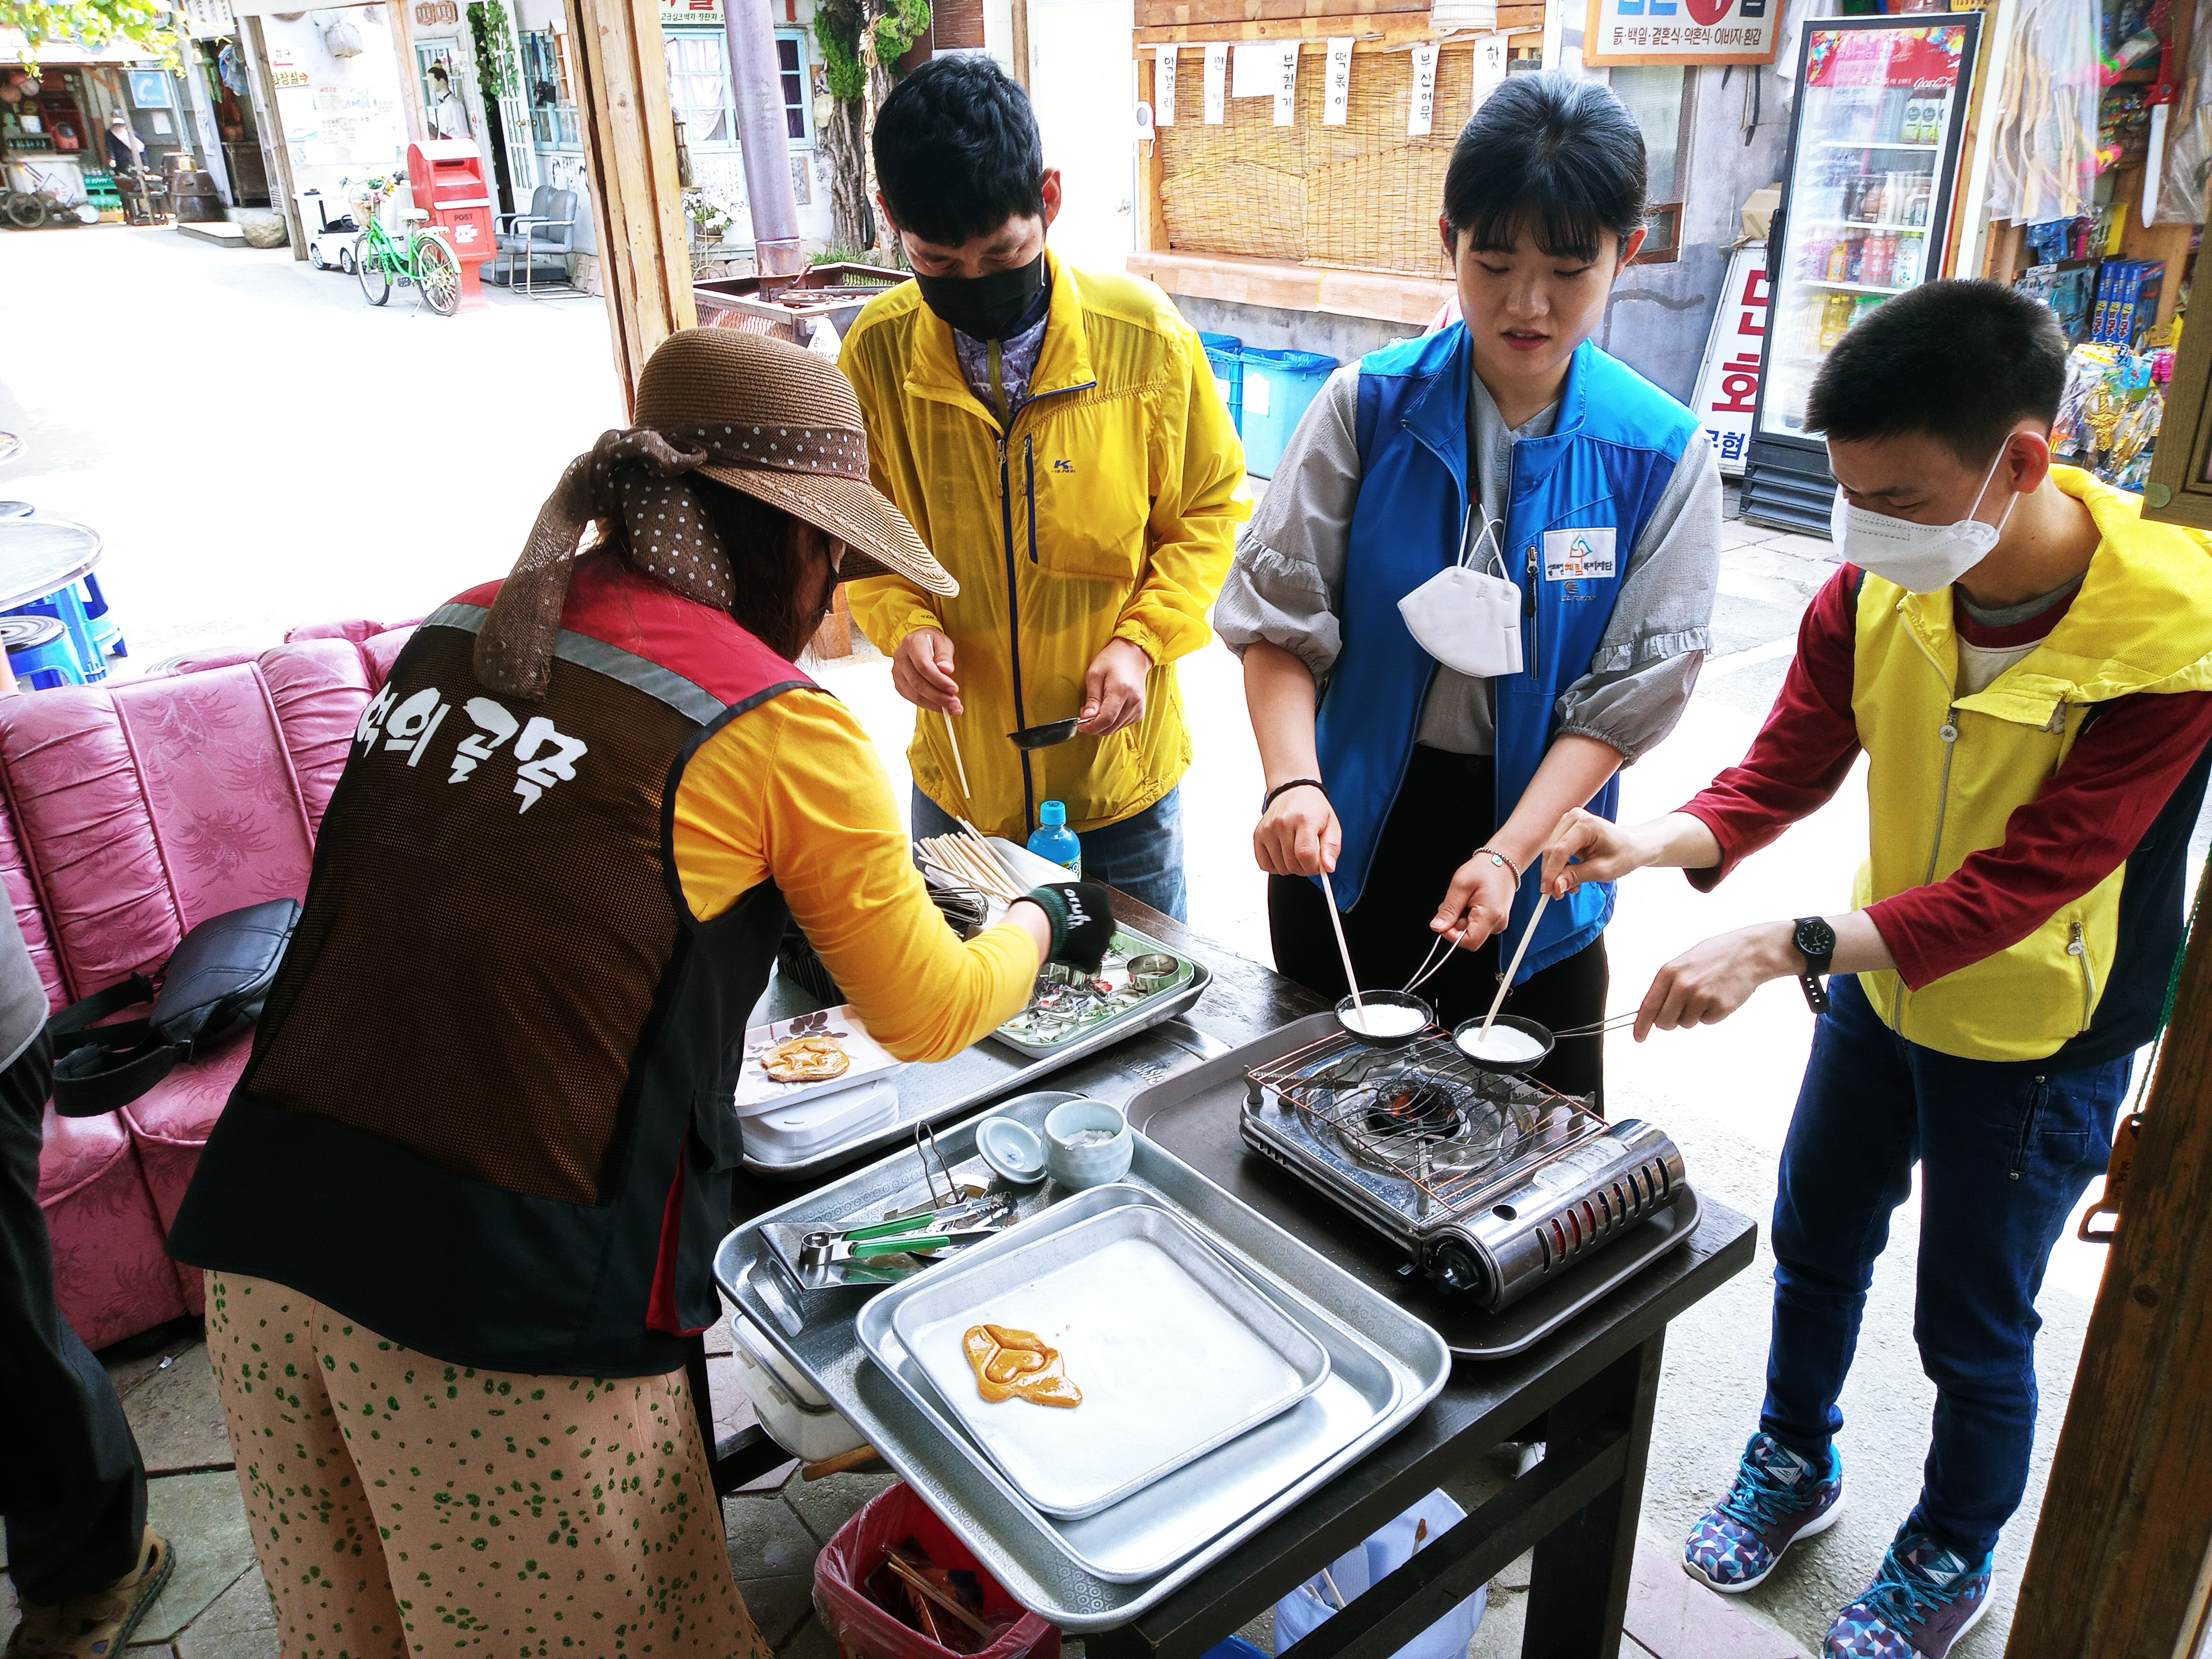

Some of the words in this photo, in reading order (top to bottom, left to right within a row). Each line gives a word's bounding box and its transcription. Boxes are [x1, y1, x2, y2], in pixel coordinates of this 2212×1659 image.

[1163, 57, 1175, 109] 막걸리
[1335, 51, 1347, 108] 떡볶이
[448, 696, 588, 814] 골목
